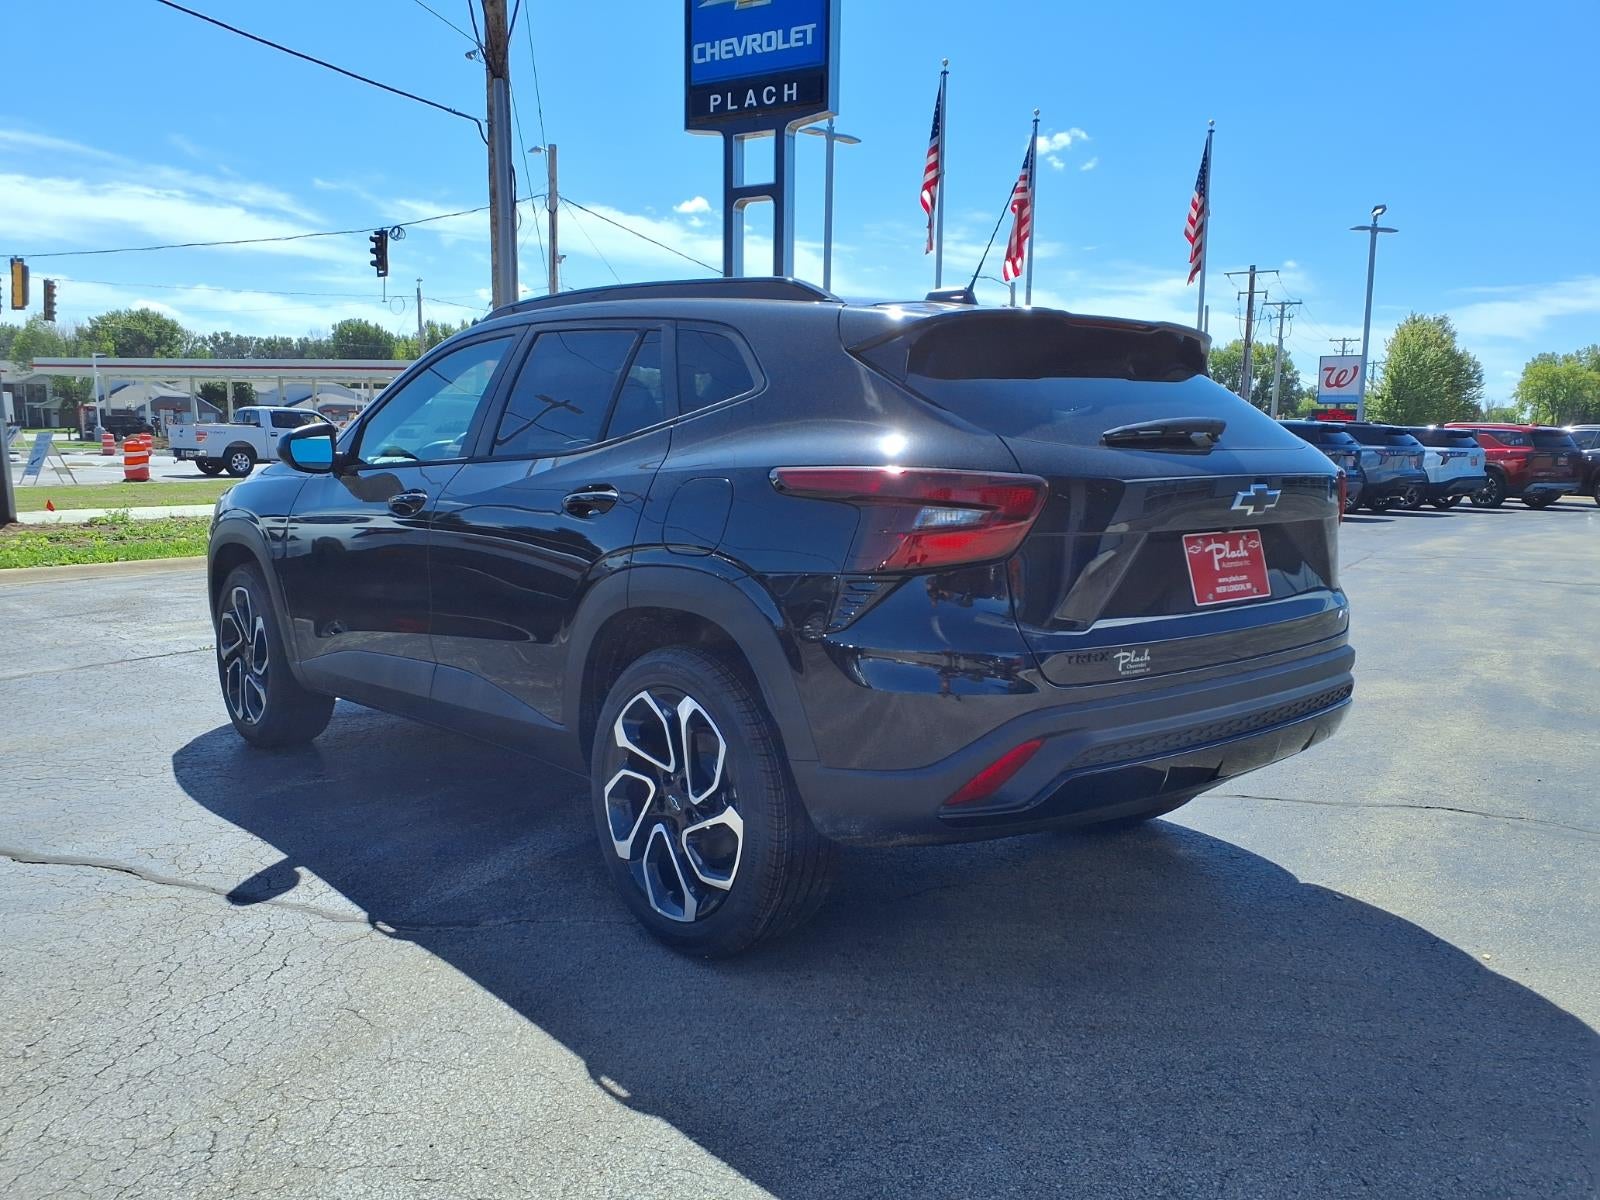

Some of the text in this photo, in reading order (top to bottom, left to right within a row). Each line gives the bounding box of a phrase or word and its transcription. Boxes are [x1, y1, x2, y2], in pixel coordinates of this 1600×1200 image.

[693, 23, 817, 64] CHEVROLET
[709, 82, 798, 113] PLACH
[1205, 538, 1249, 571] Plach
[1113, 648, 1151, 672] Plach
